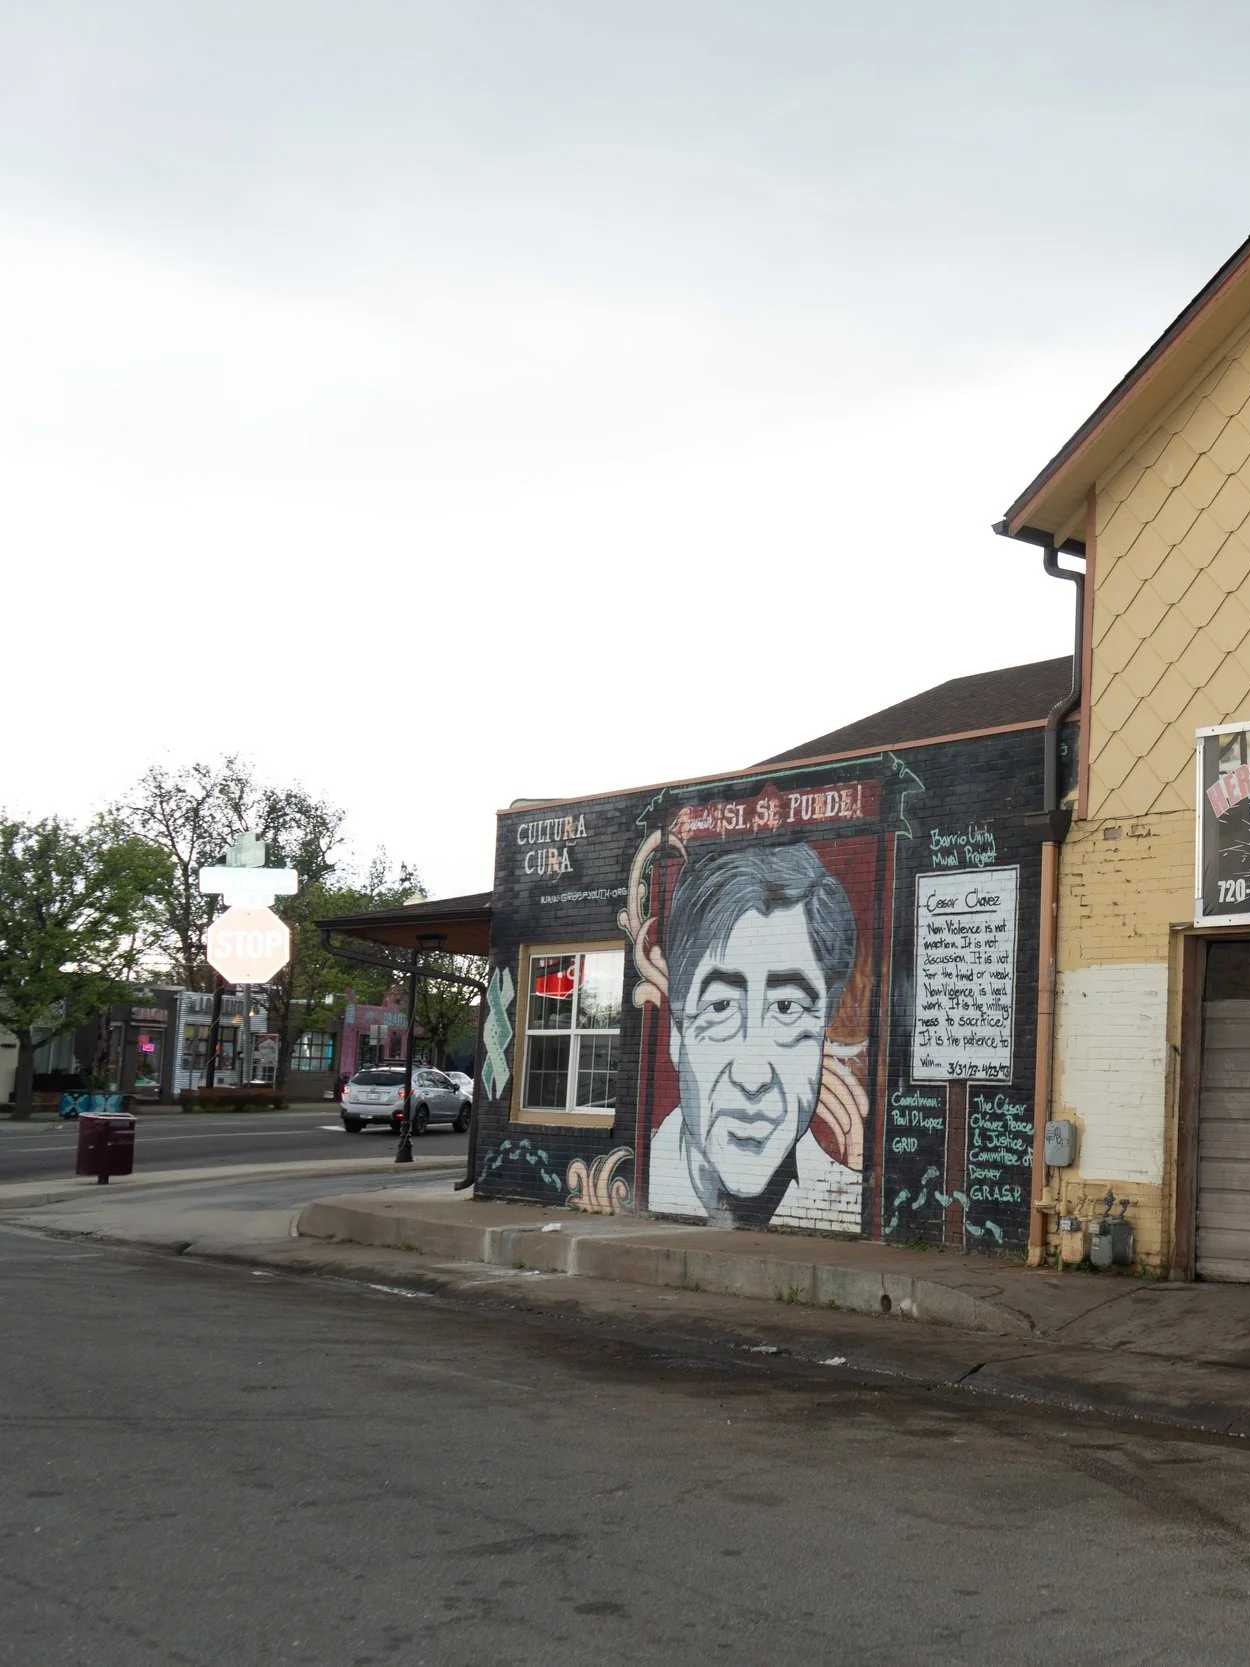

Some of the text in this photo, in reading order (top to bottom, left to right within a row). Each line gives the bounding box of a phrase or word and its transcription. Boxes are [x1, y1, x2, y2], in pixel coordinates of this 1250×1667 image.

[786, 784, 864, 823] PUEDE!
[517, 814, 587, 846] CULTURA
[930, 825, 996, 851] Barrio Unity
[524, 847, 574, 876] CURA
[932, 845, 997, 868] Mural Project
[985, 920, 993, 933] is
[994, 917, 1007, 933] not
[216, 931, 282, 958] STOP
[960, 935, 973, 949] It
[974, 938, 982, 948] is
[984, 934, 998, 949] not
[923, 949, 1009, 965] discussion. It is not
[941, 966, 953, 980] the
[955, 963, 974, 982] timid
[976, 970, 986, 979] or
[978, 983, 986, 996] is
[989, 981, 1008, 996] hard
[948, 996, 960, 1010] It
[961, 998, 970, 1010] is
[971, 996, 985, 1012] the
[945, 1011, 955, 1026] to
[918, 1028, 1009, 1051] It is the patience to
[973, 1094, 994, 1113] The
[891, 1109, 909, 1126] Paul
[1005, 1115, 1035, 1135] Peace
[892, 1137, 918, 1154] GRID
[973, 1128, 983, 1147] &
[969, 1147, 1021, 1165] Committee
